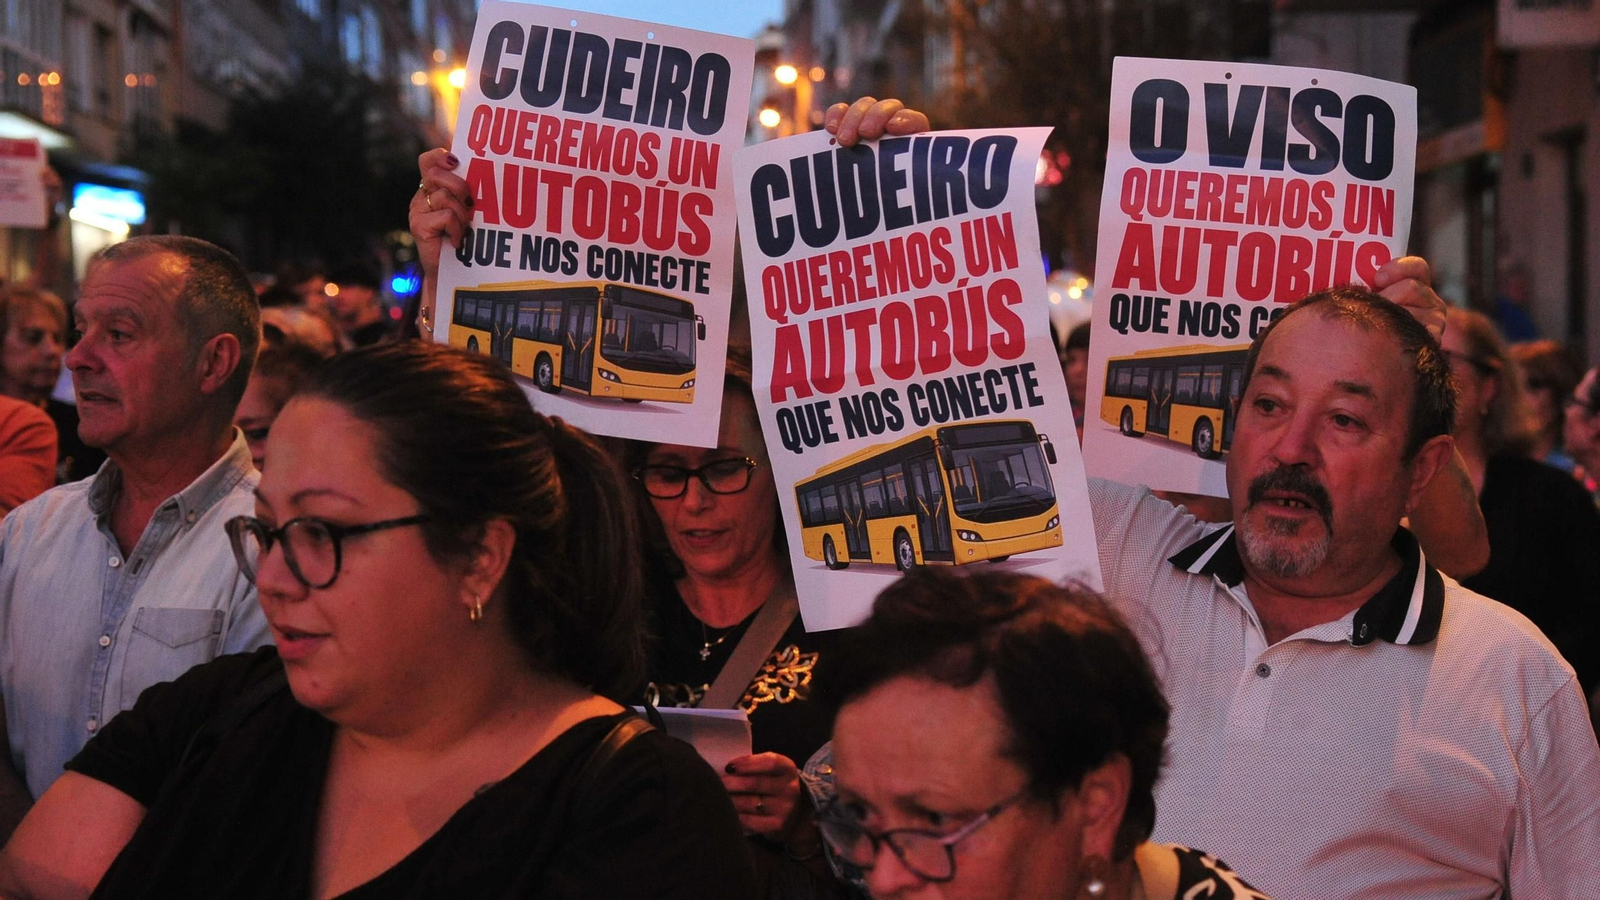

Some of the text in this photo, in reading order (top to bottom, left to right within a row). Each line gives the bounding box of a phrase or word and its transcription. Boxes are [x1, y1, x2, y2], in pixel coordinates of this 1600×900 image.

[479, 20, 731, 135] CUDEIRO
[467, 104, 721, 190] QUEREMOS UN
[1129, 78, 1395, 181] O VISO
[465, 157, 714, 256] AUTOBÚS
[750, 135, 1018, 257] CUDEIRO
[1119, 167, 1395, 237] QUEREMOS UN
[455, 227, 711, 294] QUE NOS CONECTE
[761, 212, 1019, 324] QUEREMOS UN
[770, 277, 1026, 404] AUTOBÚS
[1109, 293, 1170, 335] QUE
[1177, 300, 1241, 339] NOS
[776, 362, 1045, 454] QUE NOS CONECTE
